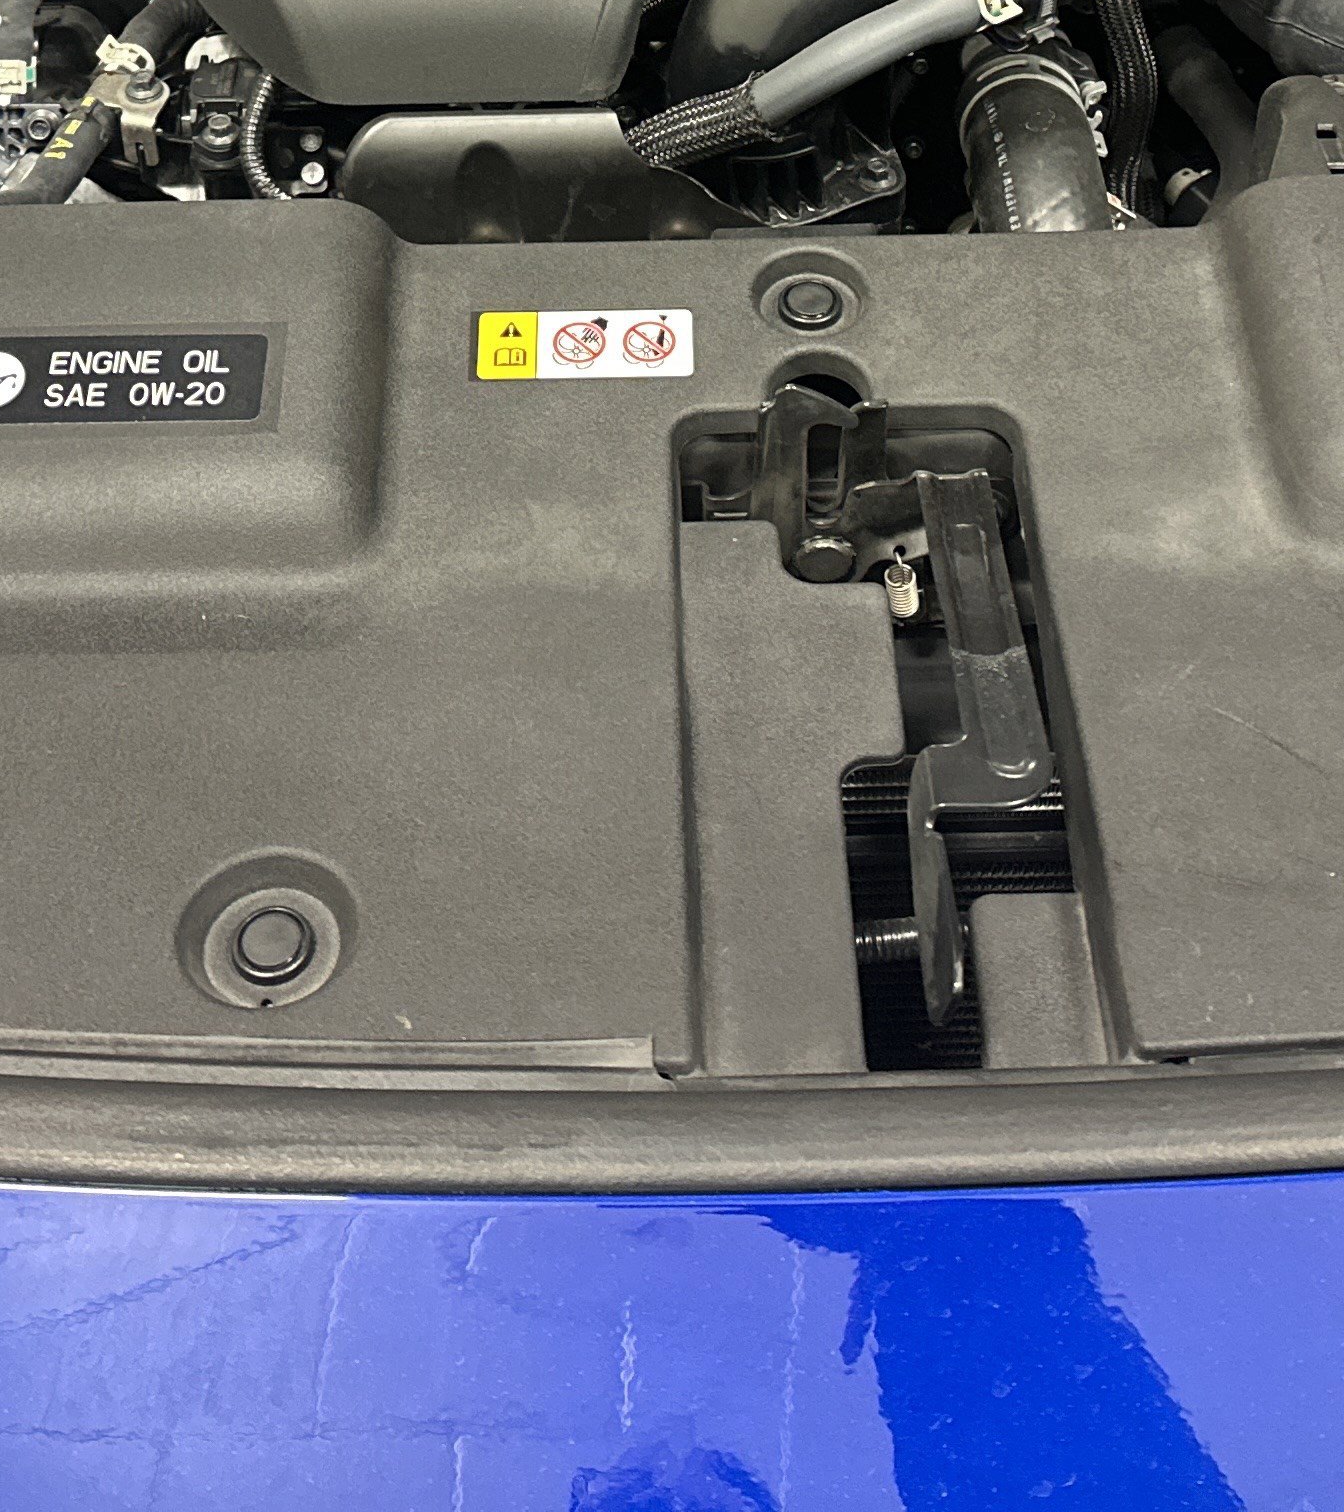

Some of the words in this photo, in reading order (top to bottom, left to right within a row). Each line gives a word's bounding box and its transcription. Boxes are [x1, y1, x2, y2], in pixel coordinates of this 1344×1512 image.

[48, 350, 162, 375] ENGINE
[182, 349, 230, 374] OIL
[43, 382, 108, 407] SAE
[128, 381, 226, 406] 0W-20
